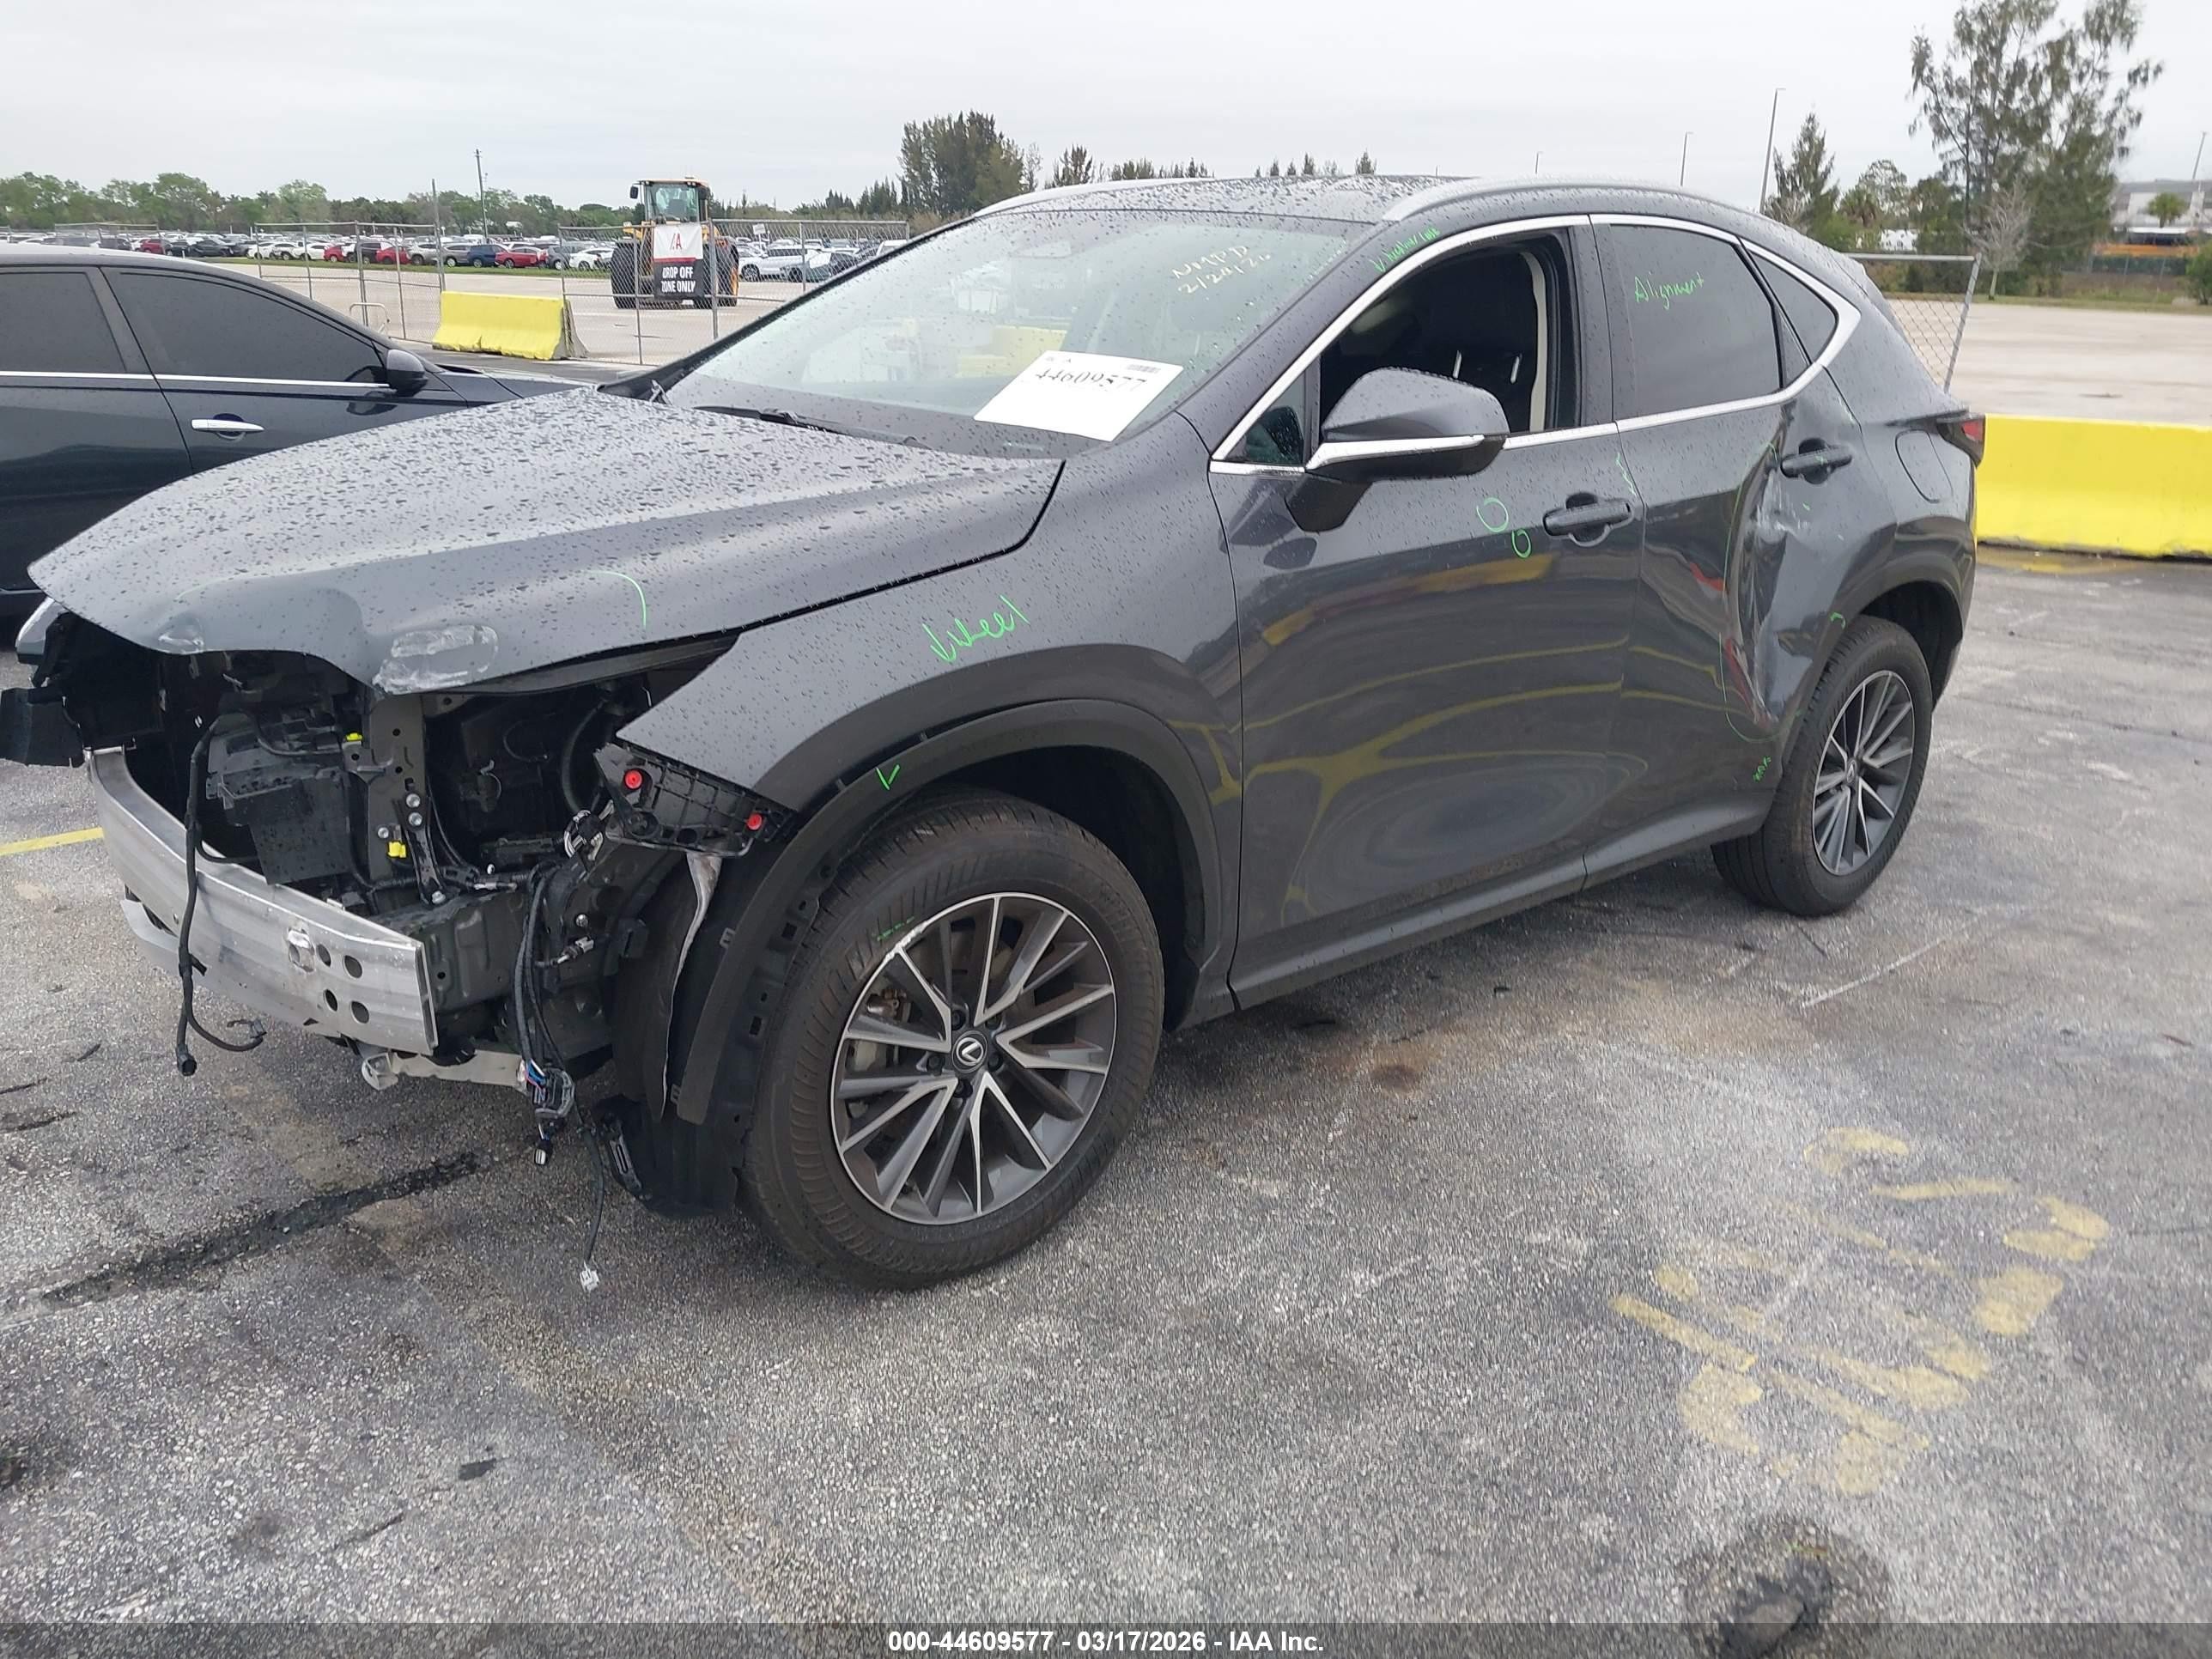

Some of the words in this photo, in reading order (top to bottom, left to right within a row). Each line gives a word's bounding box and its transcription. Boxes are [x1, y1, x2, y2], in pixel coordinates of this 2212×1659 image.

[662, 266, 678, 278] DROP
[680, 266, 694, 278] OFF
[661, 281, 677, 293] ZONE
[677, 281, 696, 293] ONLY
[1634, 270, 1705, 310] Alignment
